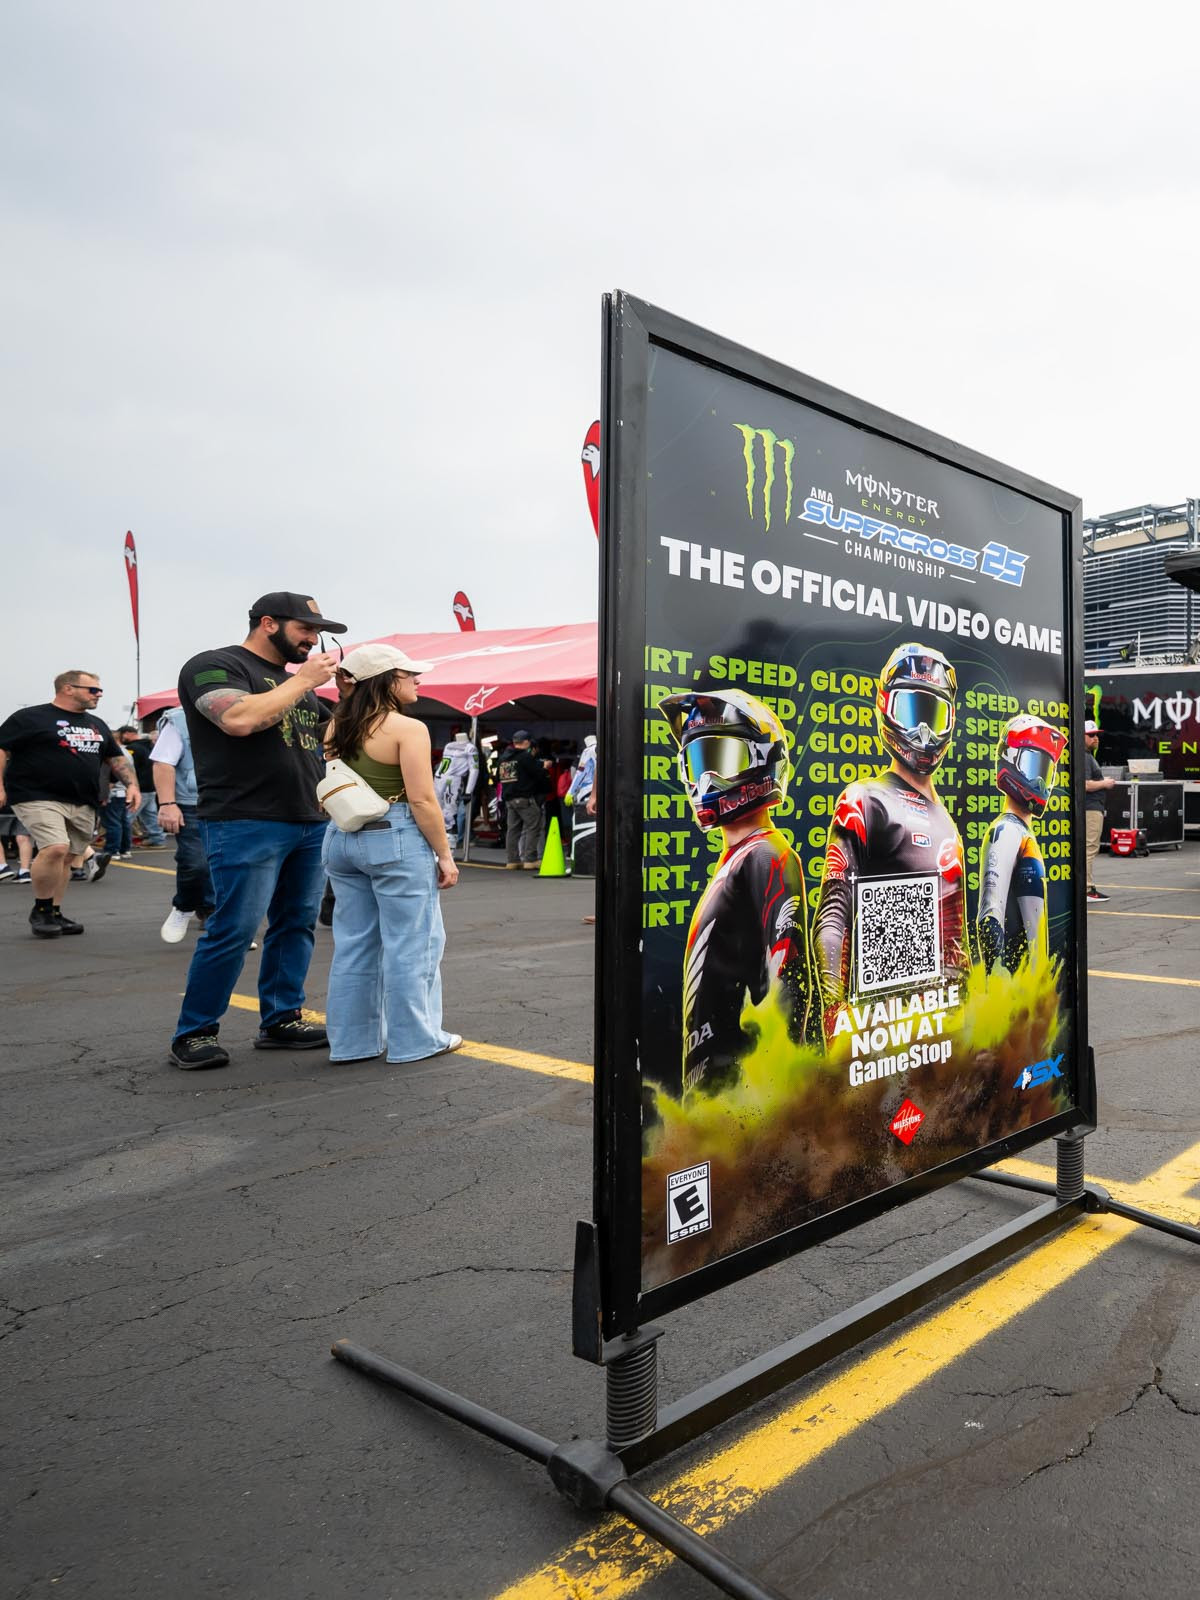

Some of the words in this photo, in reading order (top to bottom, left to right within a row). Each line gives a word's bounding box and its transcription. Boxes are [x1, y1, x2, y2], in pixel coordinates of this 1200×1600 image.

[810, 486, 834, 505] AMA
[845, 469, 941, 519] MONSTER
[861, 499, 926, 526] ENERGY
[797, 497, 980, 570] SUPERCROSS
[980, 540, 1030, 587] 25
[845, 540, 945, 579] CHAMPIONSHIP
[660, 535, 745, 590] THE
[751, 560, 903, 623] OFFICIAL
[906, 596, 990, 640] VIDEO
[994, 618, 1062, 655] GAME
[709, 655, 805, 692] SPEED,
[810, 703, 878, 728] GLOR
[833, 985, 960, 1036] AVAILABLE
[852, 1020, 913, 1058] NOW
[917, 1011, 947, 1040] AT
[849, 1039, 952, 1087] GameStop
[893, 1114, 921, 1131] MILESTONE
[671, 1167, 706, 1186] EVERYONE
[673, 1184, 705, 1226] E
[670, 1221, 709, 1241] ESRB
